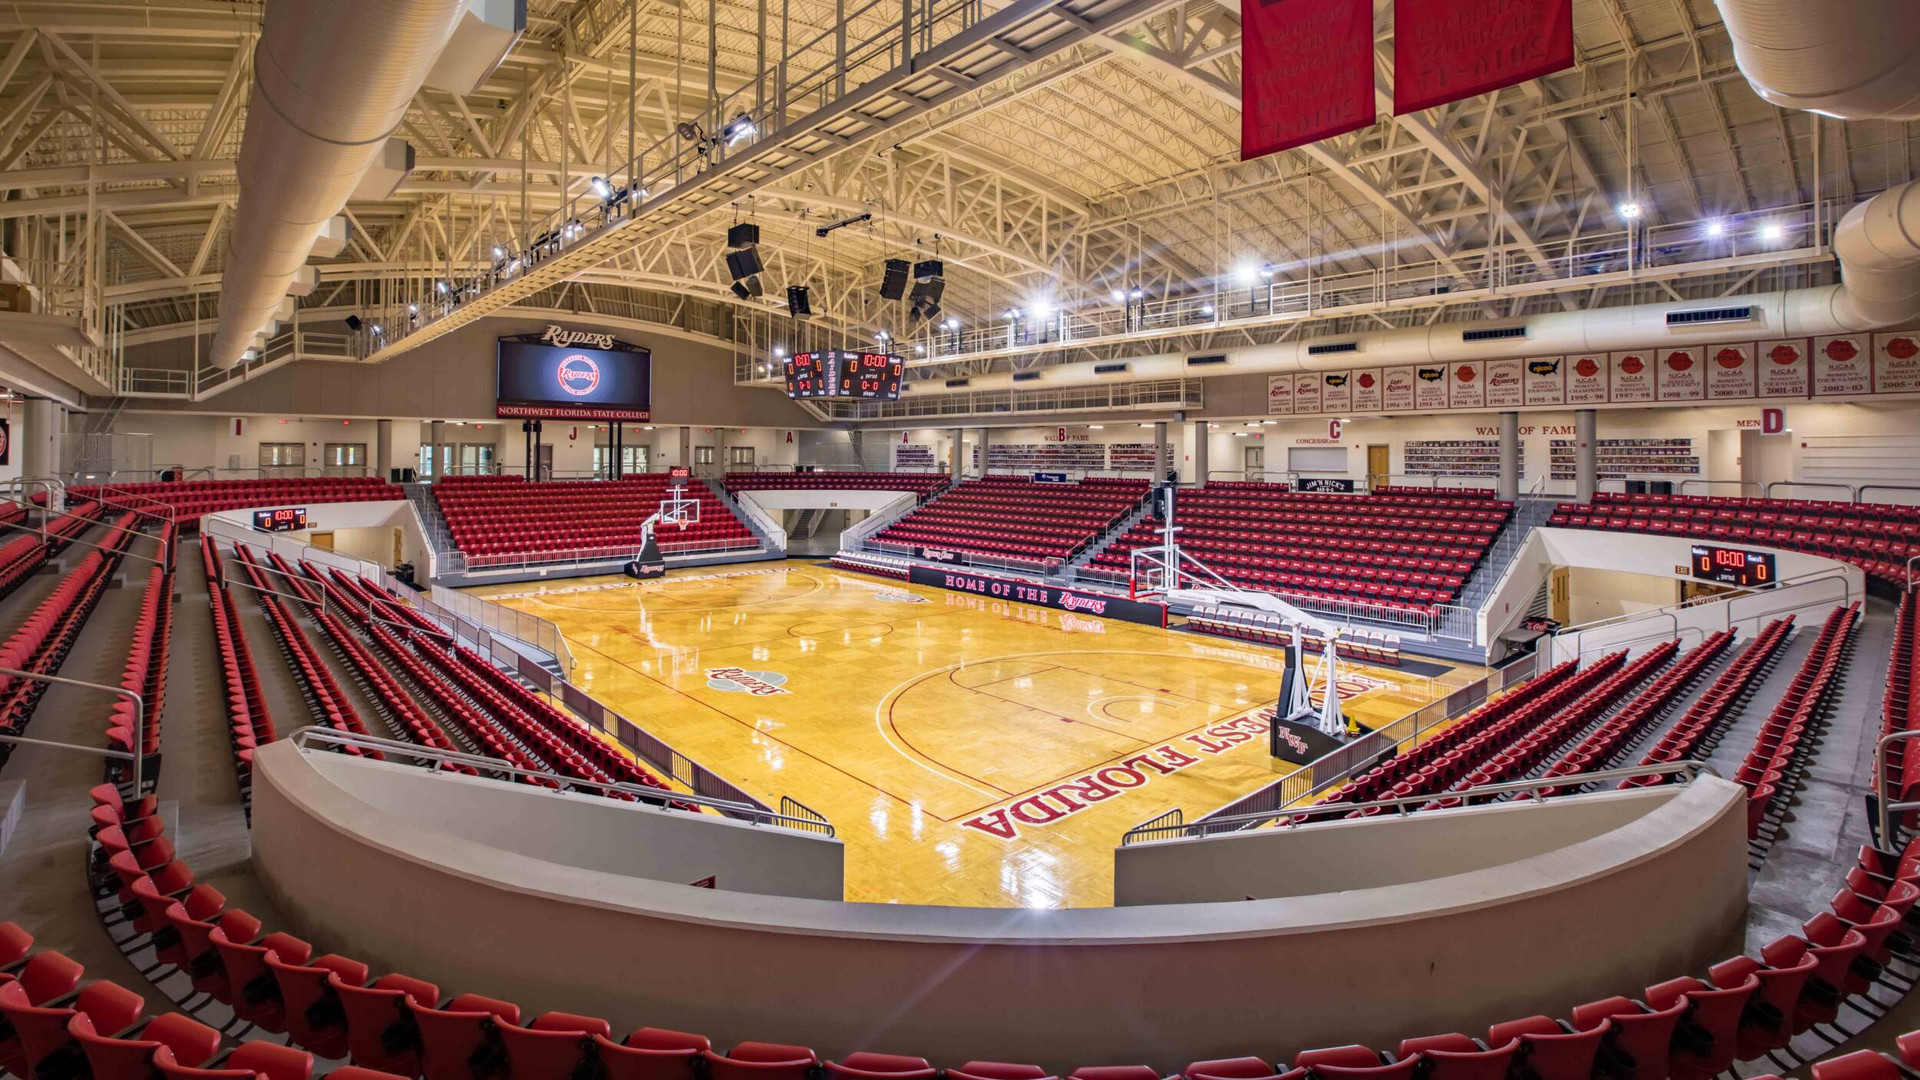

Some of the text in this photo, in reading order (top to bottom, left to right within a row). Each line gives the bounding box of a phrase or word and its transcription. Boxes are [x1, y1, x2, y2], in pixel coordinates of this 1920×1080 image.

[541, 325, 615, 350] RAIDERS
[850, 360, 901, 376] 0 0
[864, 354, 887, 368] 10:00
[844, 380, 850, 388] 0
[891, 383, 897, 391] 0
[1489, 378, 1519, 386] RAIDERS
[498, 407, 555, 416] NORTHWEST
[1763, 408, 1783, 433] D
[569, 427, 578, 440] J
[1059, 428, 1065, 442] B
[1330, 420, 1340, 439] C
[1519, 427, 1536, 435] OF
[787, 432, 793, 443] A
[903, 432, 908, 443] A
[672, 469, 688, 477] 10:00
[1325, 480, 1345, 490] NICK'S
[265, 515, 305, 527] 0 0
[1716, 550, 1744, 567] 10:00
[1702, 556, 1766, 580] 0 0
[1742, 574, 1746, 584] 1
[946, 575, 1106, 614] HOME OF THE RAIDERS
[706, 667, 786, 695] RAIDERS
[1279, 726, 1308, 754] NWF
[962, 744, 1200, 840] FLORIDA
